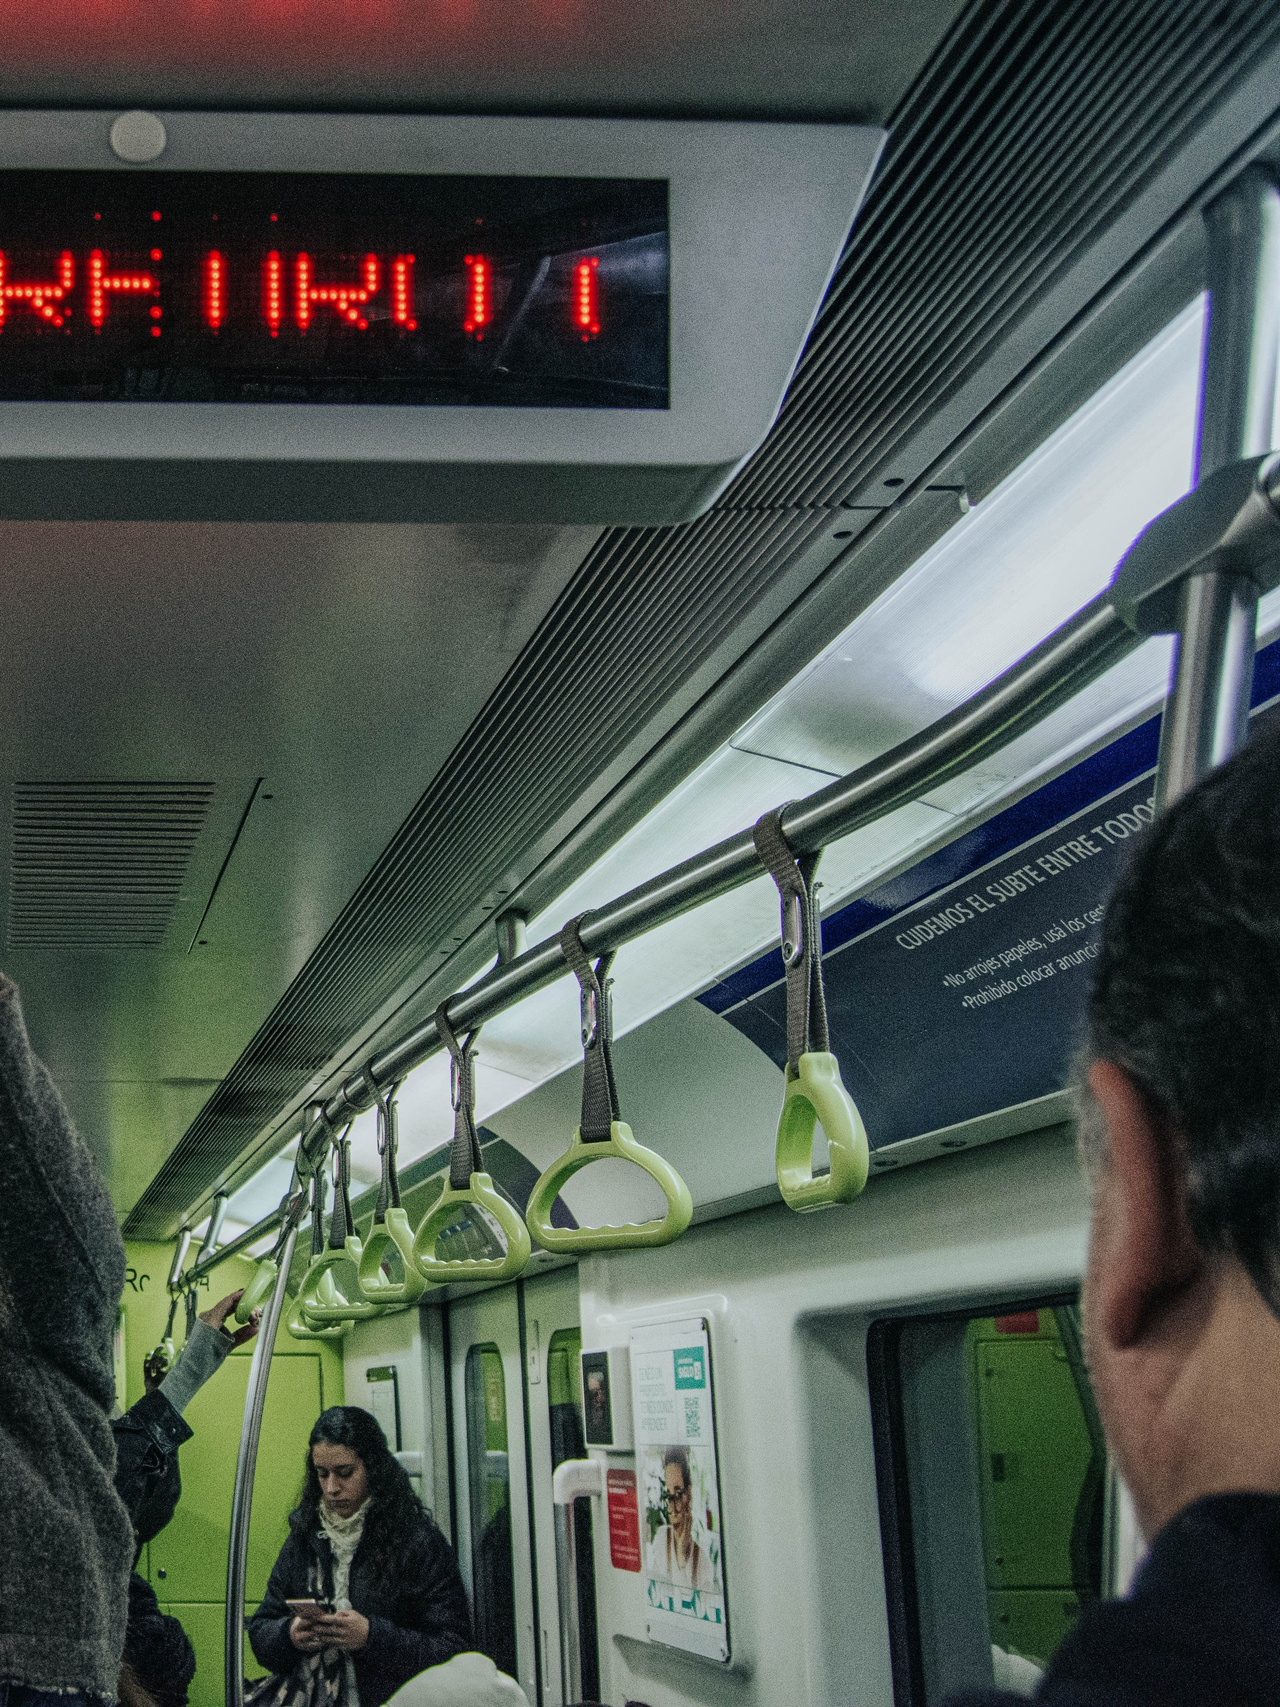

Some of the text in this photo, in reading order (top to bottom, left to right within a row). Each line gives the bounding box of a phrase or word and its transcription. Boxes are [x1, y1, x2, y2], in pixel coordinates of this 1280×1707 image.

[895, 902, 975, 950] CUIDEMOS
[966, 894, 996, 913] EL
[985, 865, 1047, 903] SUBTE
[1035, 834, 1103, 876] ENTRE
[963, 957, 1001, 976] arrojes
[998, 938, 1048, 968] papeles,
[1042, 923, 1068, 944] usá
[1060, 919, 1086, 934] los
[963, 979, 1019, 1009] Prohibido
[1016, 968, 1058, 988] colocar
